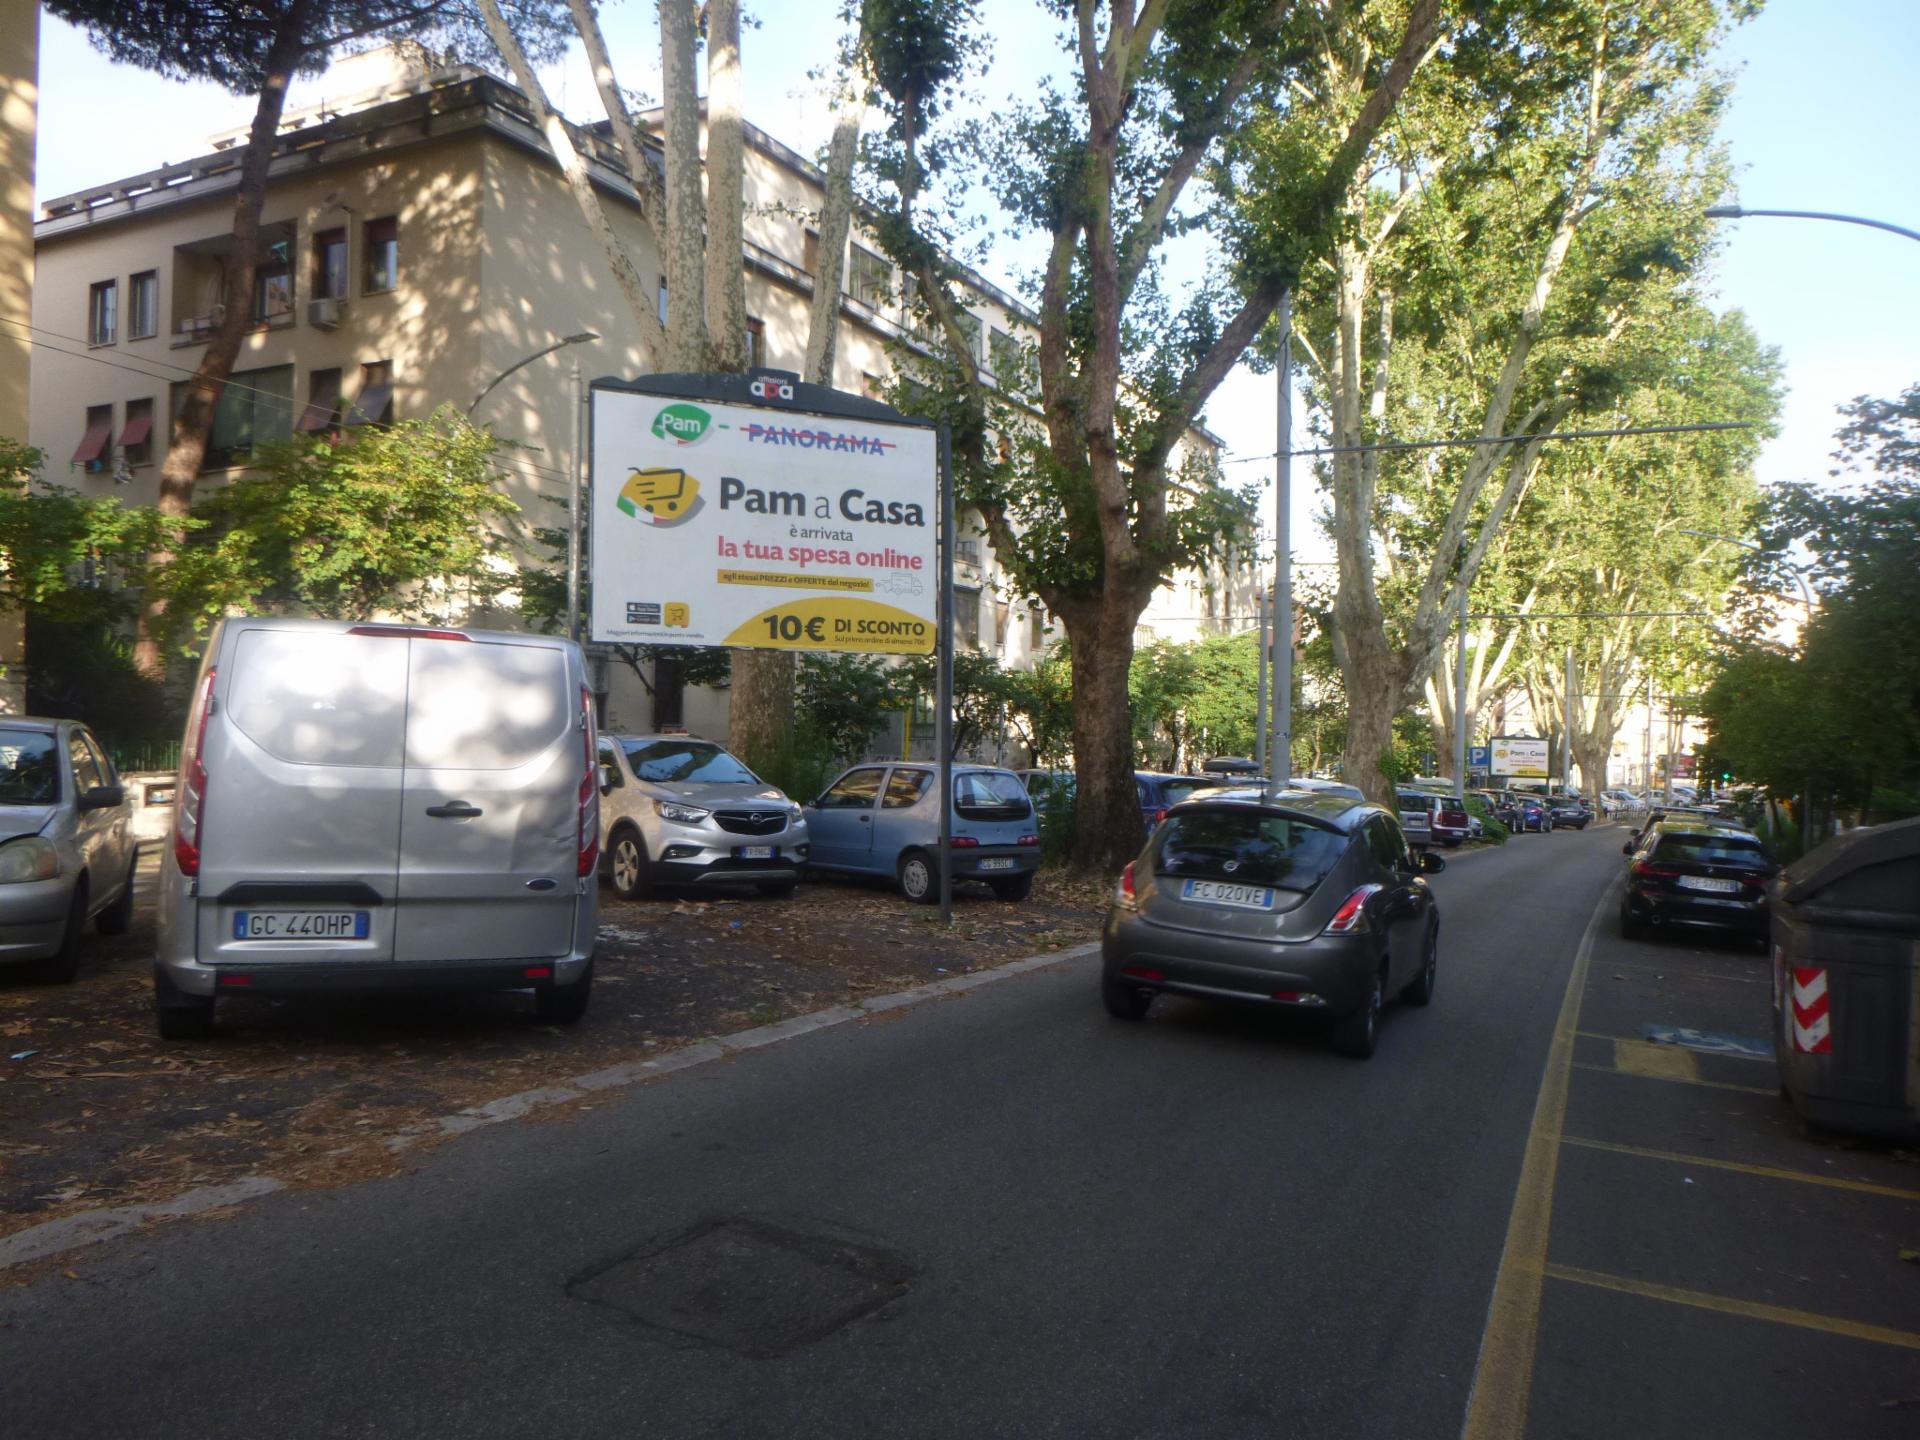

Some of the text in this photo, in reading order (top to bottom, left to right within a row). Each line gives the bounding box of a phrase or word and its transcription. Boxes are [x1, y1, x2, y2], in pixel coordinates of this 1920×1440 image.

[751, 381, 793, 400] apa
[661, 413, 884, 456] Pam PANORAMA
[720, 476, 925, 527] Pam a Casa
[790, 525, 853, 541] è arrivata
[718, 535, 922, 569] la tua spesa online
[759, 575, 787, 583] PREZZI
[794, 576, 827, 585] OFFERTE
[834, 619, 851, 633] DI
[857, 619, 925, 637] SCONTO
[1472, 748, 1485, 764] P
[1192, 882, 1263, 904] FC 020VE
[251, 915, 352, 935] GC 440HP
